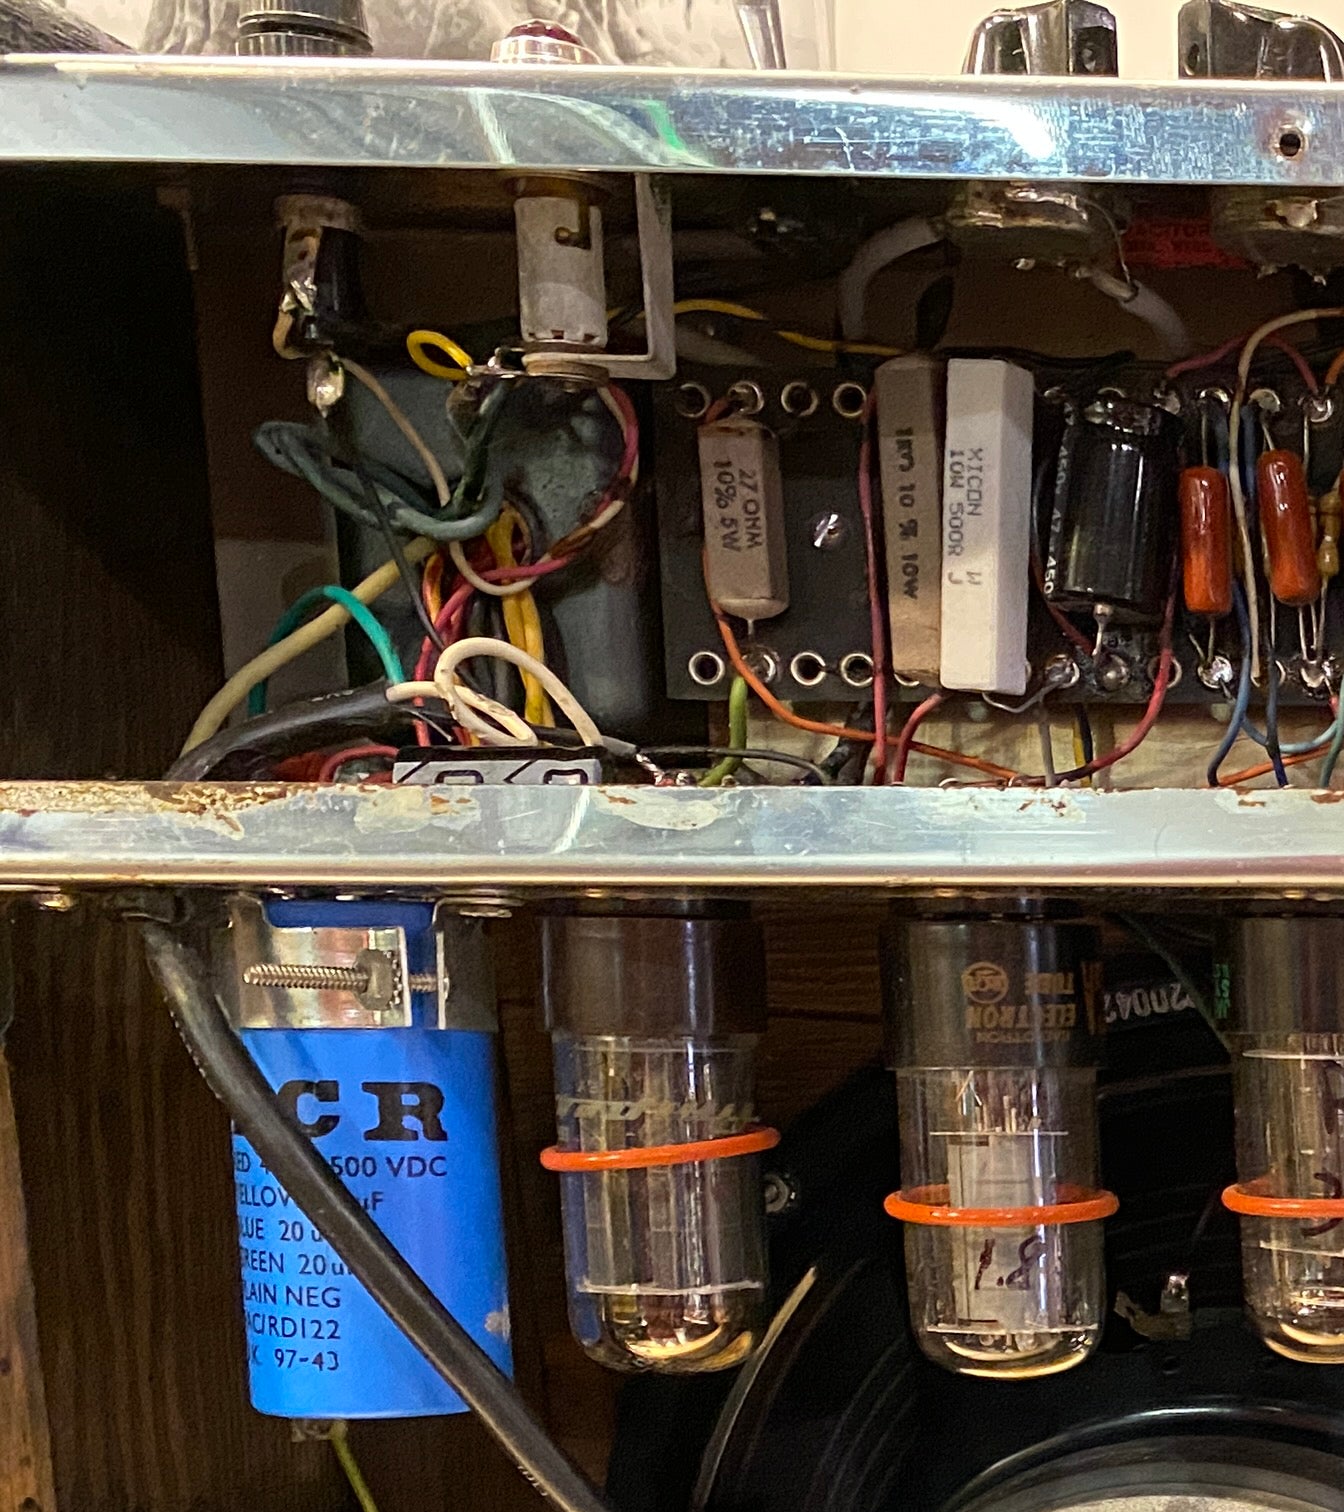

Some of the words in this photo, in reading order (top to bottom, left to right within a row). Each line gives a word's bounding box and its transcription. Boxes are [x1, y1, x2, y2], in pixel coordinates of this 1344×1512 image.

[738, 468, 759, 499] 27
[949, 449, 965, 489] 10W
[966, 447, 984, 517] XICON
[713, 460, 737, 510] 10%
[744, 502, 763, 549] OHM
[948, 501, 964, 557] 500R
[386, 1156, 448, 1178] VDC
[239, 1186, 292, 1208] ELLO
[241, 1219, 265, 1241] LUE
[278, 1220, 305, 1242] 20
[245, 1247, 285, 1273] REEN
[298, 1254, 327, 1276] 20
[245, 1281, 277, 1305] LAIN
[285, 1285, 341, 1308] NEG
[274, 1348, 339, 1371] 97-43
